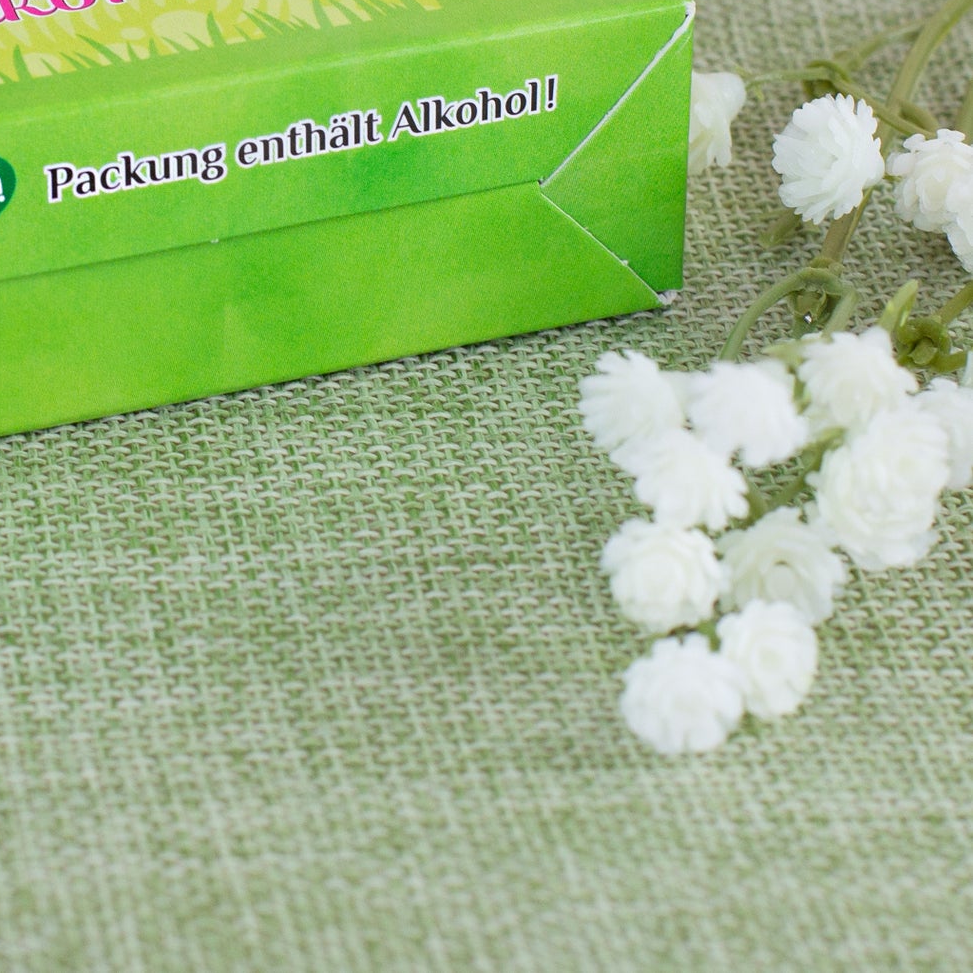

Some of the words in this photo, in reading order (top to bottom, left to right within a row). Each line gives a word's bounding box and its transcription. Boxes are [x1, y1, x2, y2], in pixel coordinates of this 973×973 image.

[47, 141, 226, 202] Packung
[235, 108, 381, 168] enthält
[388, 76, 558, 141] Alkohol!
